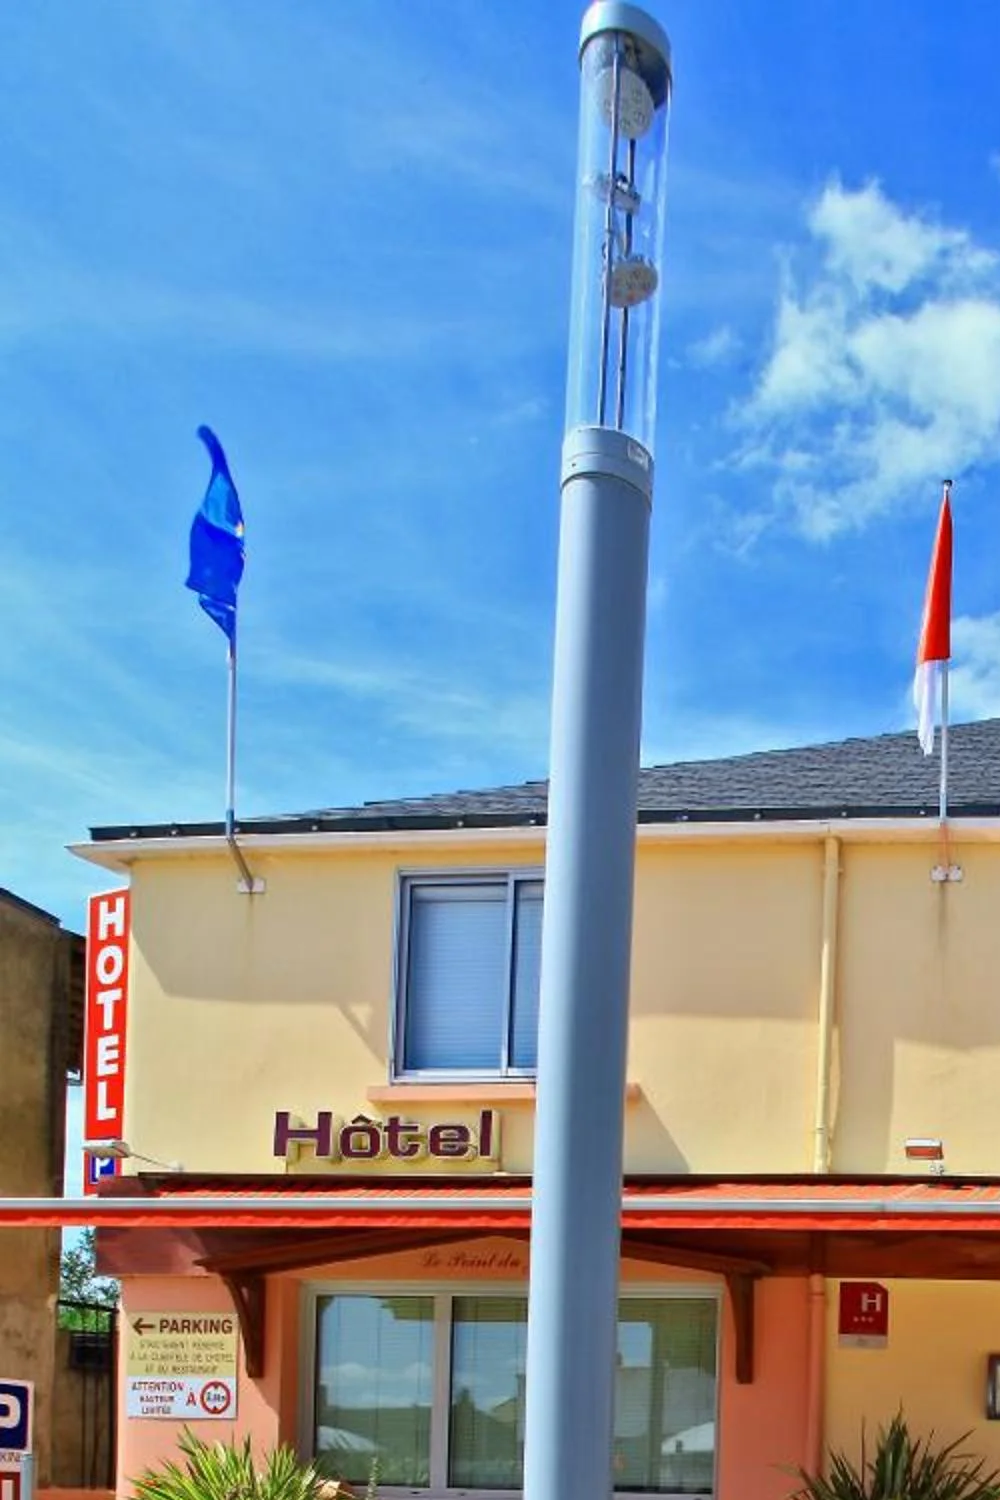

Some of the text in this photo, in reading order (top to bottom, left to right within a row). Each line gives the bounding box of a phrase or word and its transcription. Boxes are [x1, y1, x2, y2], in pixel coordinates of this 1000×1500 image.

[95, 896, 125, 1122] HOTEL
[273, 1108, 494, 1159] Hôtel
[861, 1292, 882, 1313] H
[159, 1319, 233, 1335] PARKING
[131, 1381, 185, 1392] ATTENTION
